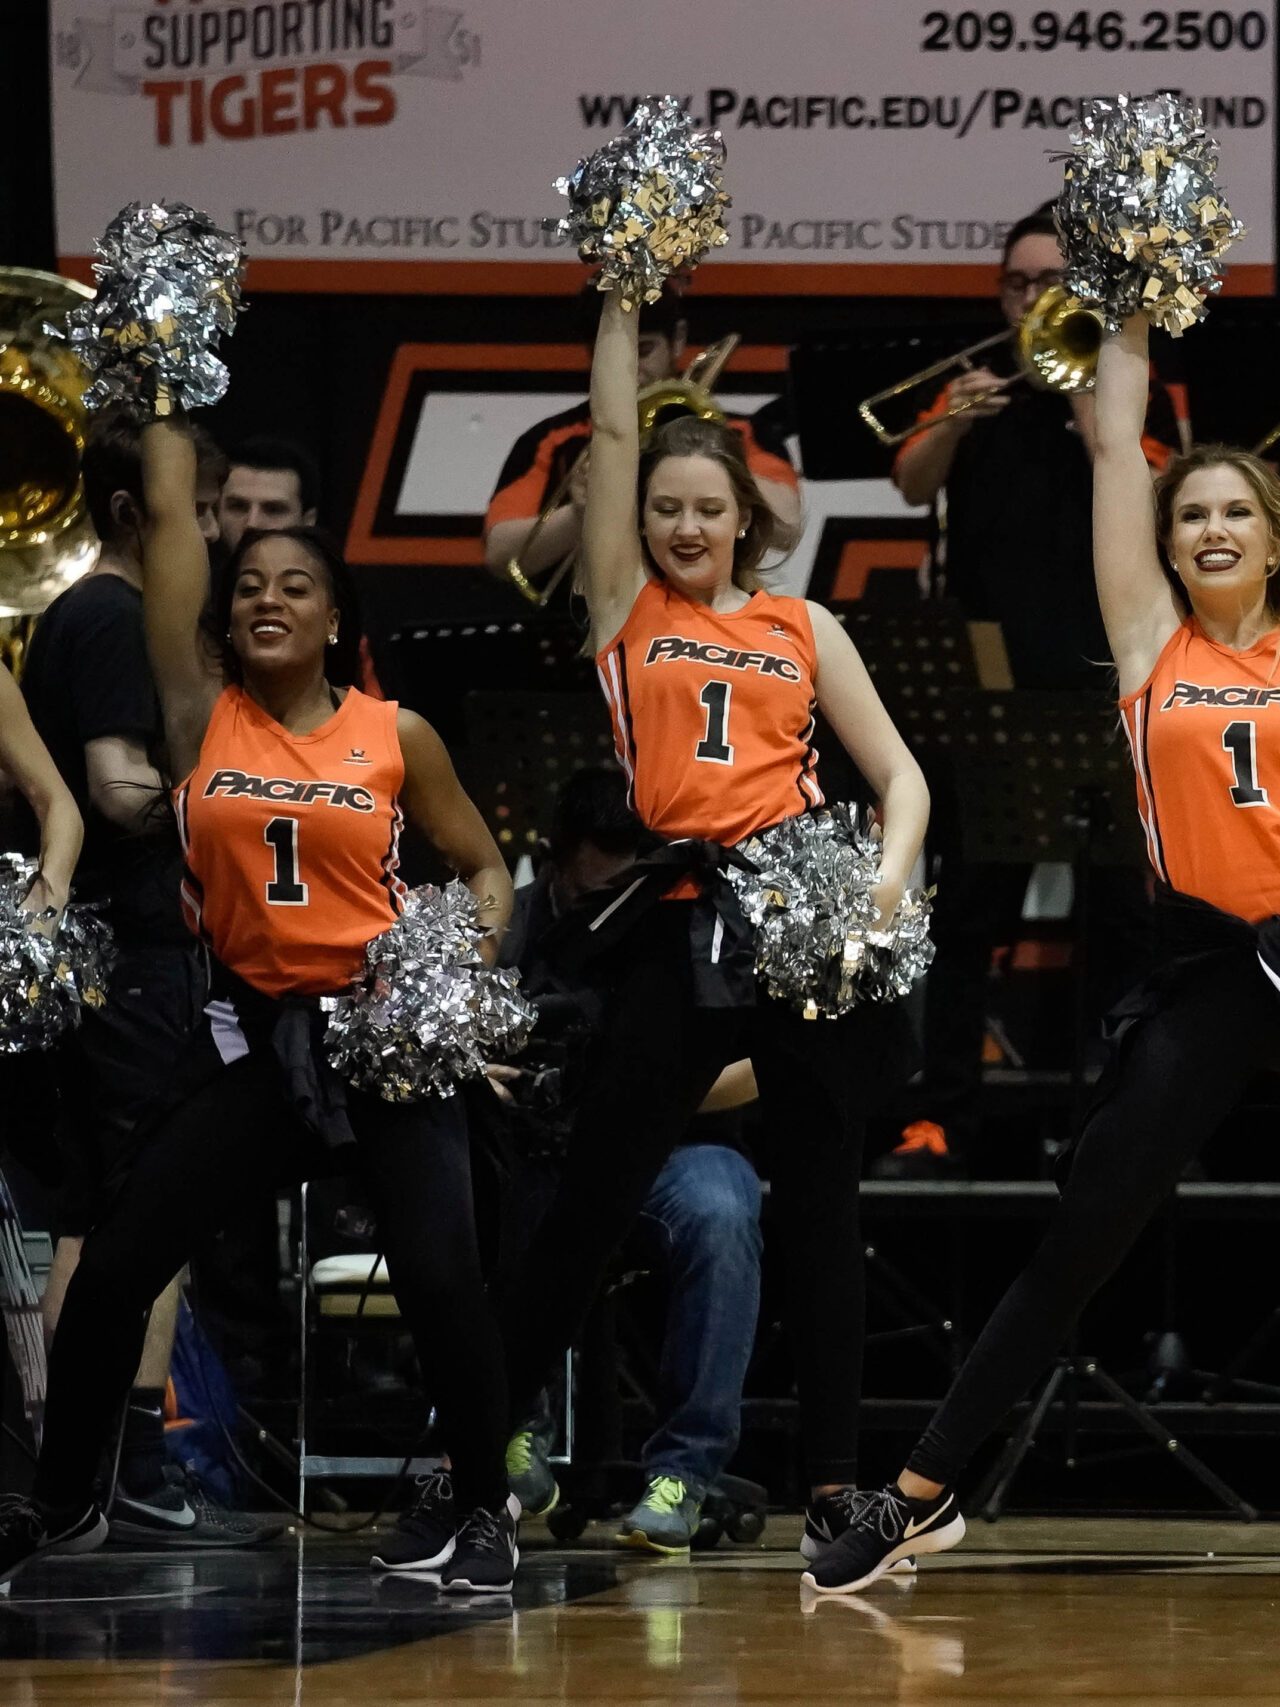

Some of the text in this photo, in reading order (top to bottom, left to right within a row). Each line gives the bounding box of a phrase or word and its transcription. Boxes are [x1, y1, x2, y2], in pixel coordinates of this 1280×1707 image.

[144, 0, 394, 69] SUPPORTING
[922, 10, 1266, 52] 209.946.2500
[142, 60, 398, 146] TIGERS
[233, 208, 308, 246] FOR
[319, 209, 460, 248] PACIFIC
[740, 213, 884, 250] PACIFIC
[644, 636, 801, 683] PACIFIC
[694, 679, 735, 767] 1
[202, 768, 376, 814] PACIFIC
[1222, 720, 1271, 809] 1
[263, 816, 309, 907] 1
